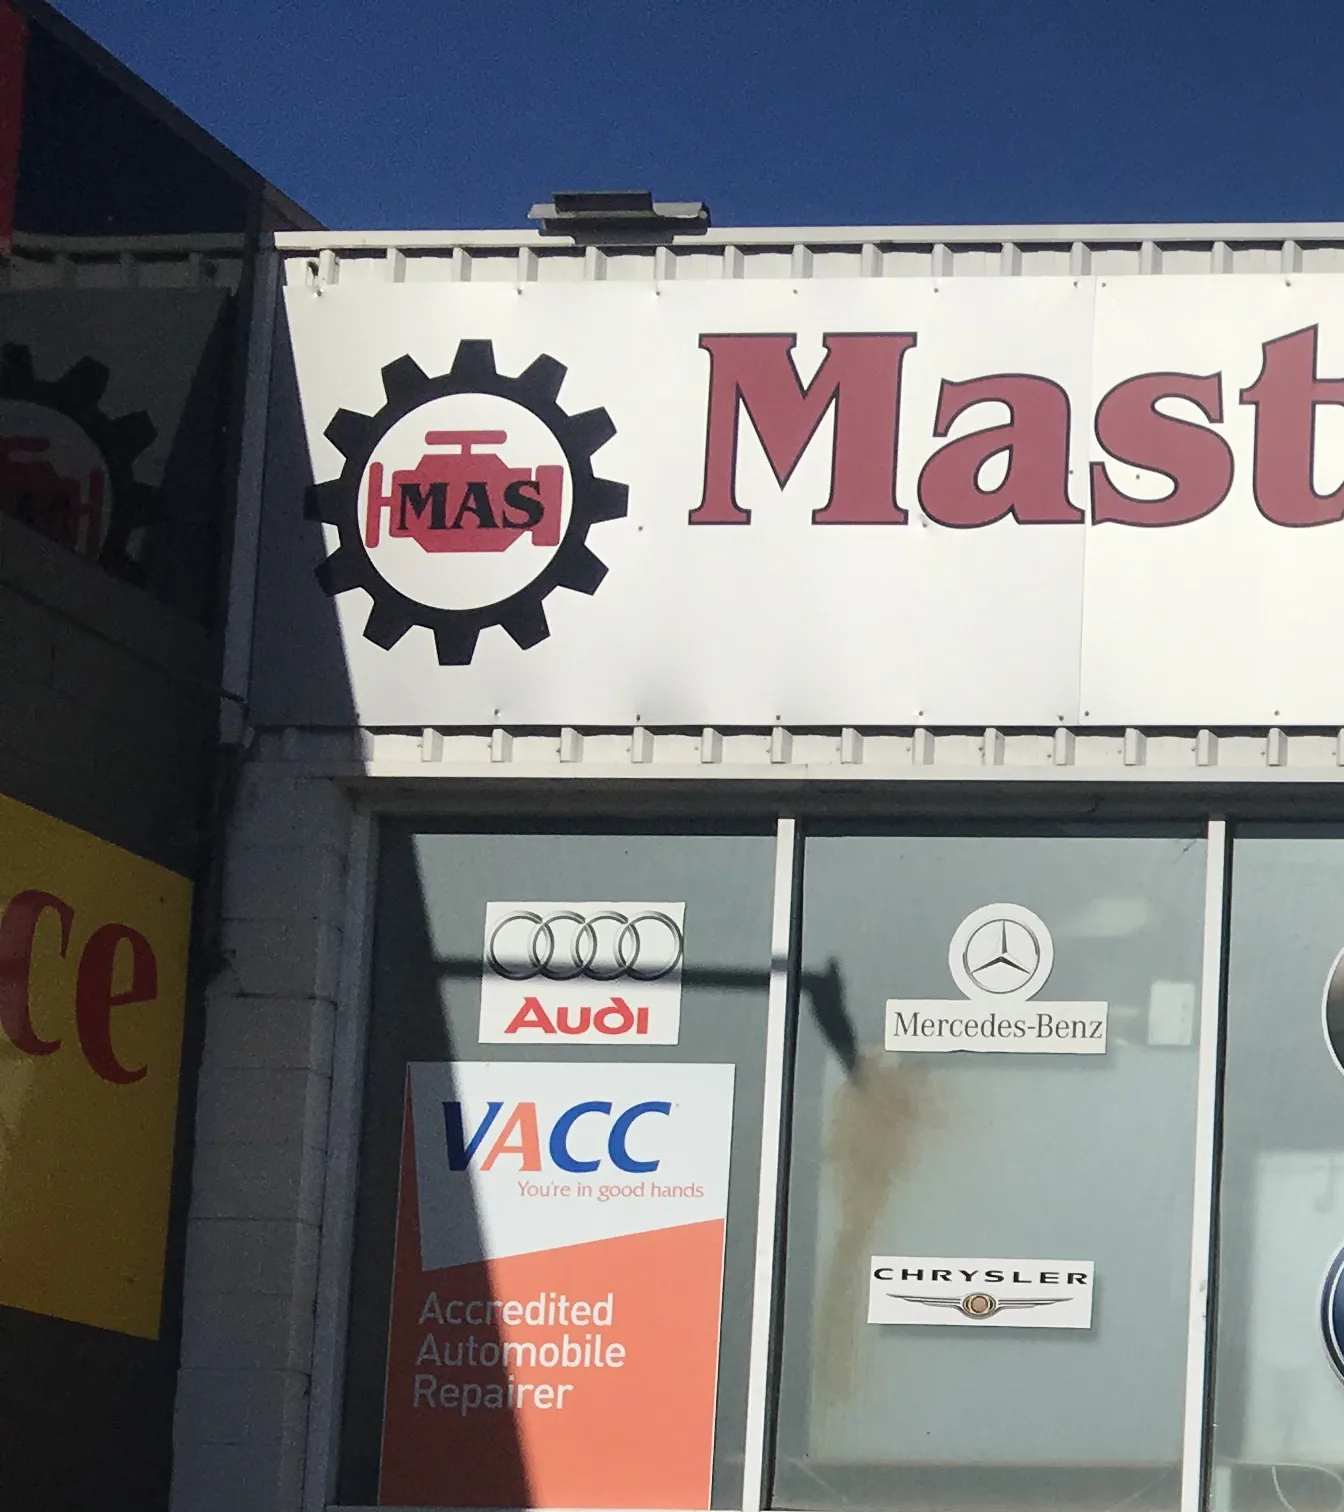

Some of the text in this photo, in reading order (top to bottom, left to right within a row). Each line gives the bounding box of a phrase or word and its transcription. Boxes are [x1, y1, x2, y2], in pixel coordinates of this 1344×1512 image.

[397, 478, 546, 536] MAS
[504, 997, 649, 1035] Audi
[894, 1011, 1103, 1040] Mercedes-Benz
[441, 1100, 672, 1173] VACC
[517, 1181, 704, 1202] You're in good hands
[873, 1266, 1088, 1286] CHRYSLER
[418, 1292, 614, 1327] Accredited
[416, 1333, 626, 1369] Automobile
[413, 1374, 574, 1416] Repairer
